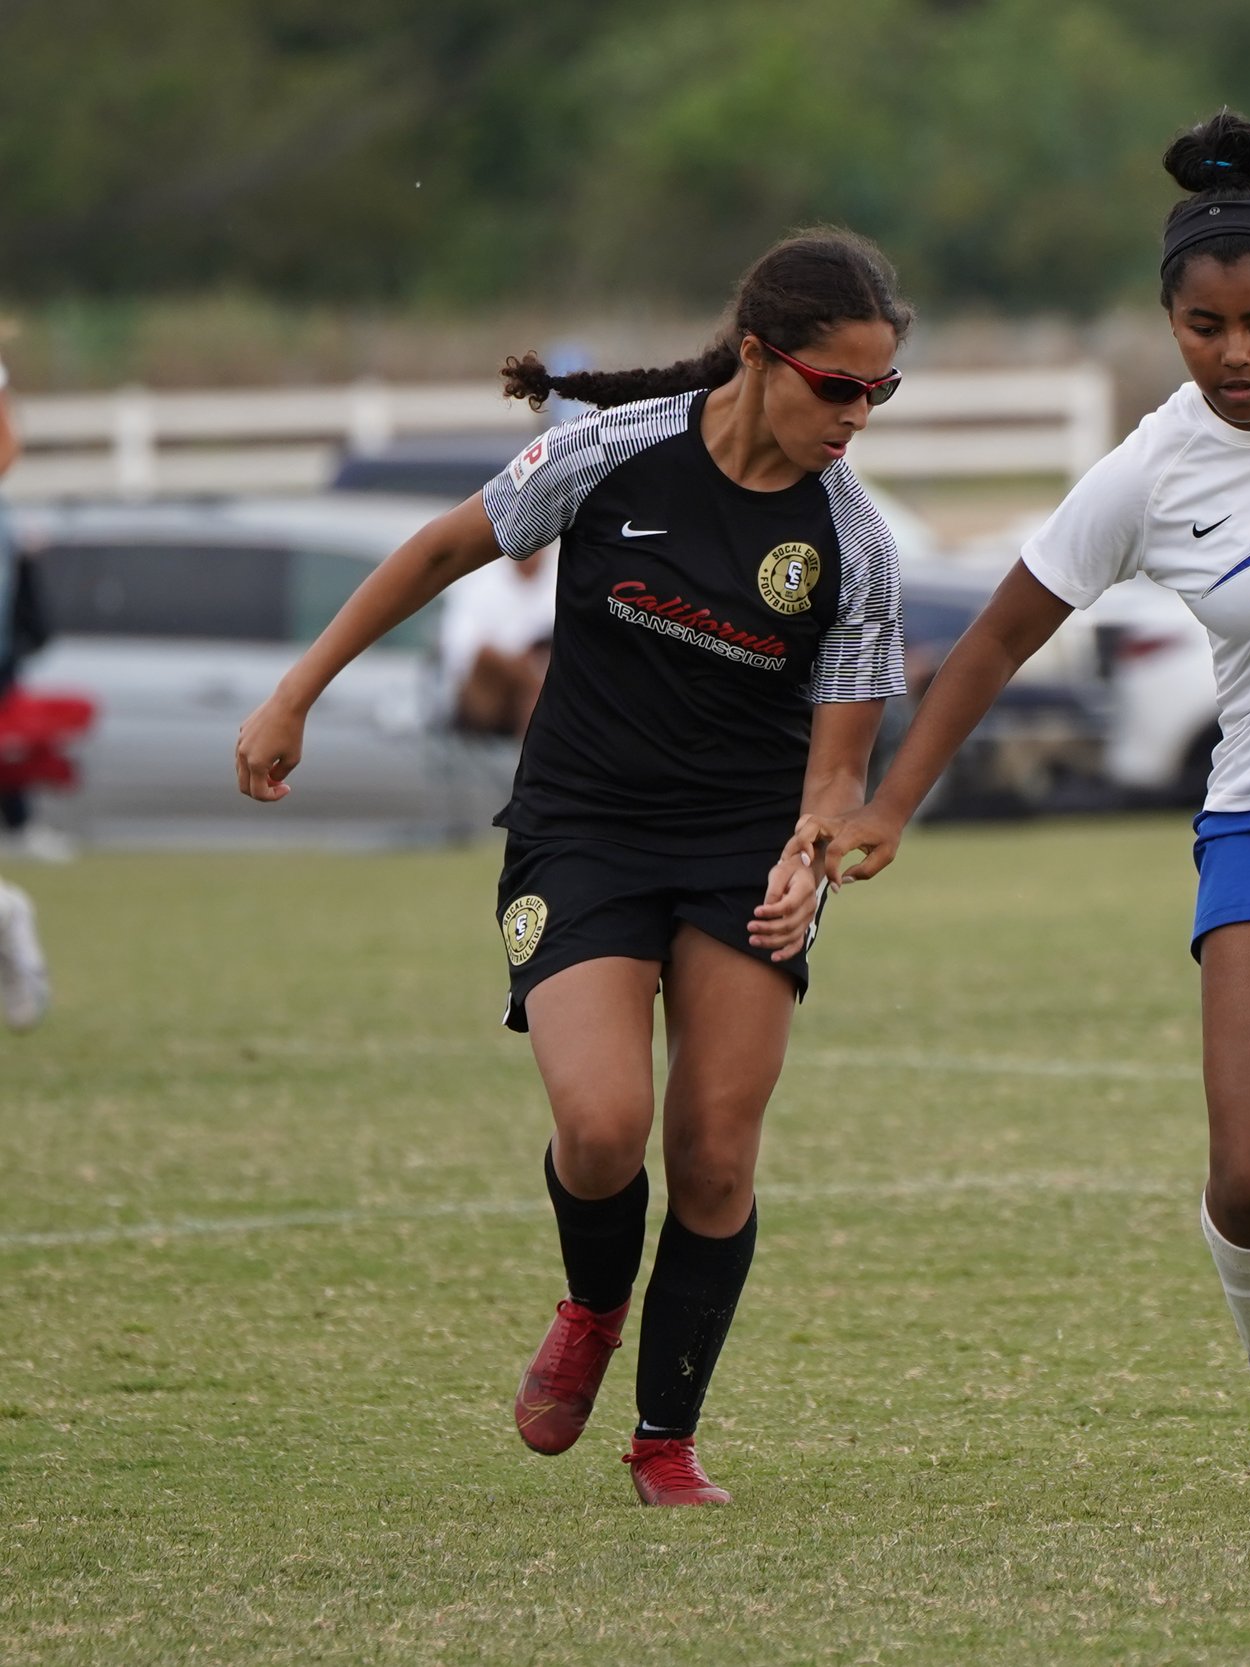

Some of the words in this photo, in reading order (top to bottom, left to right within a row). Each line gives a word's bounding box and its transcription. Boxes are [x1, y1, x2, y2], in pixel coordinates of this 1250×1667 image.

[772, 545, 802, 560] SOCAL
[804, 548, 819, 572] ELITE
[760, 576, 797, 613] FOOTBALL
[799, 600, 810, 610] CL
[607, 596, 787, 671] TRANSMISSION
[611, 581, 787, 656] California
[525, 898, 544, 911] ELITE
